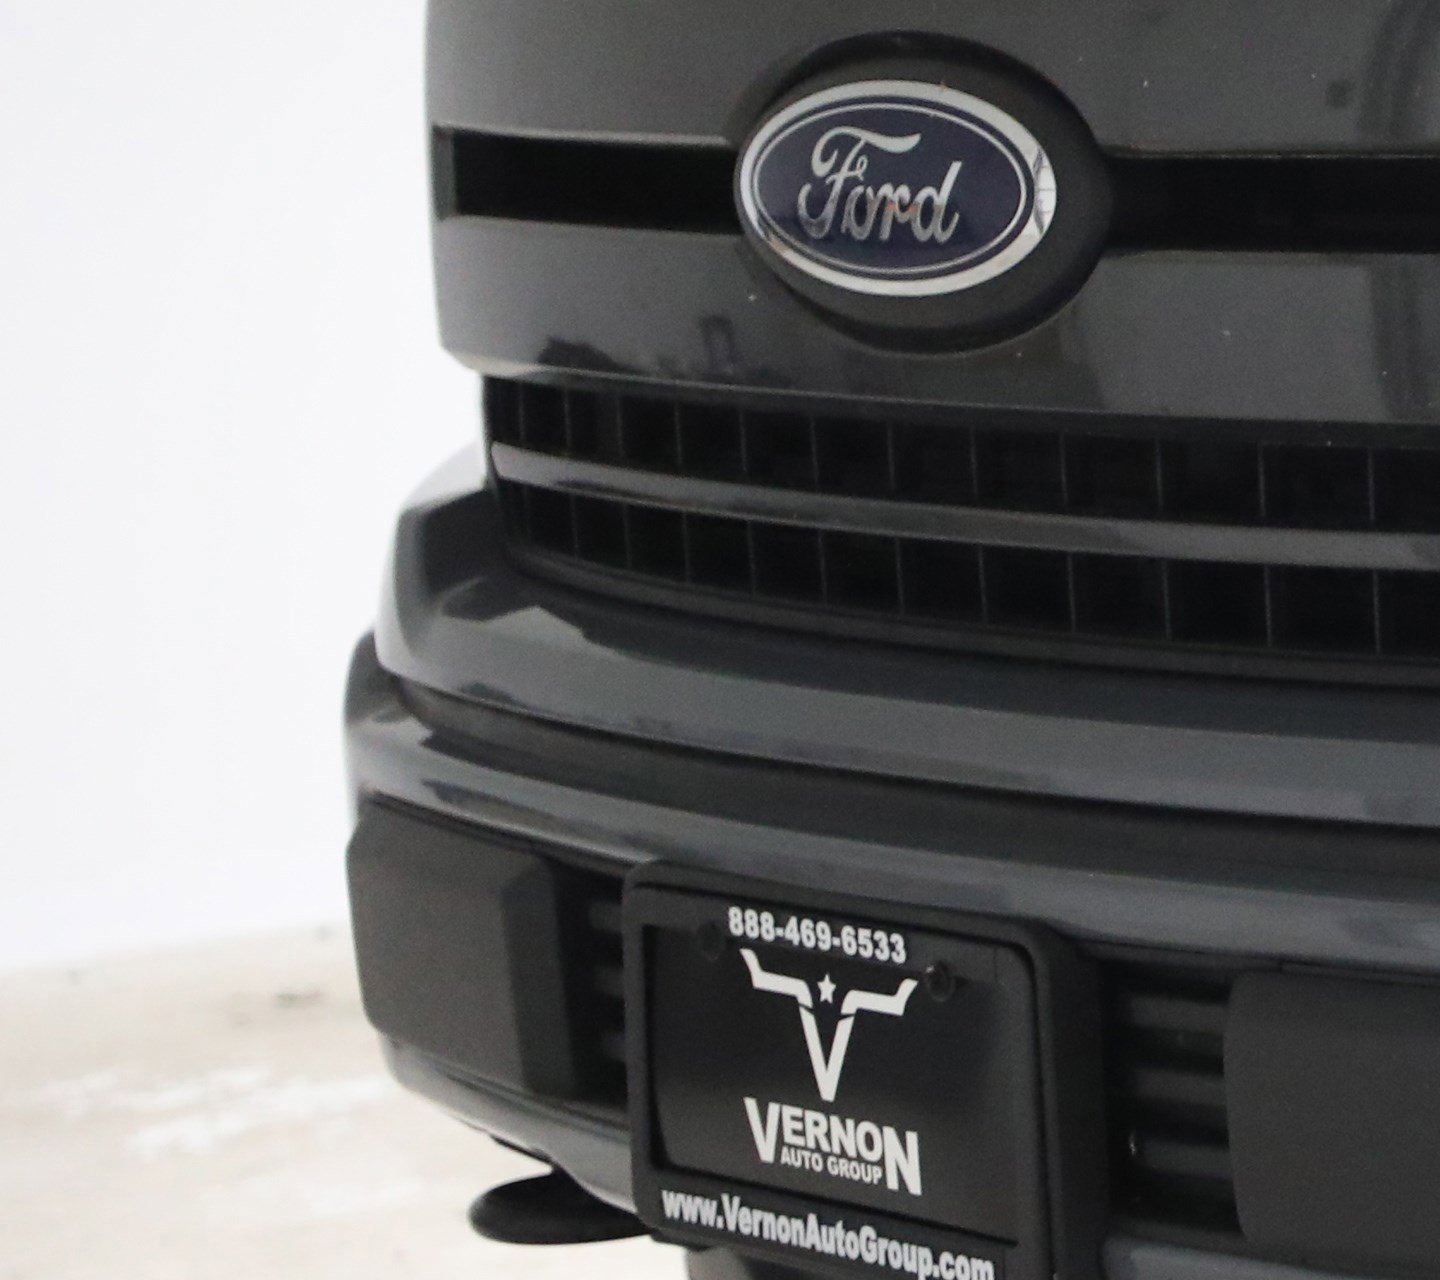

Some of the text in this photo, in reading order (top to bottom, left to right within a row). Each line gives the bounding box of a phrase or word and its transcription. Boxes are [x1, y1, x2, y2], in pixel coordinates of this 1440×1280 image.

[797, 125, 963, 244] Ford
[728, 906, 907, 964] 888-469-6533
[743, 1096, 923, 1197] VERNON
[780, 1145, 883, 1187] AUTO GROUP
